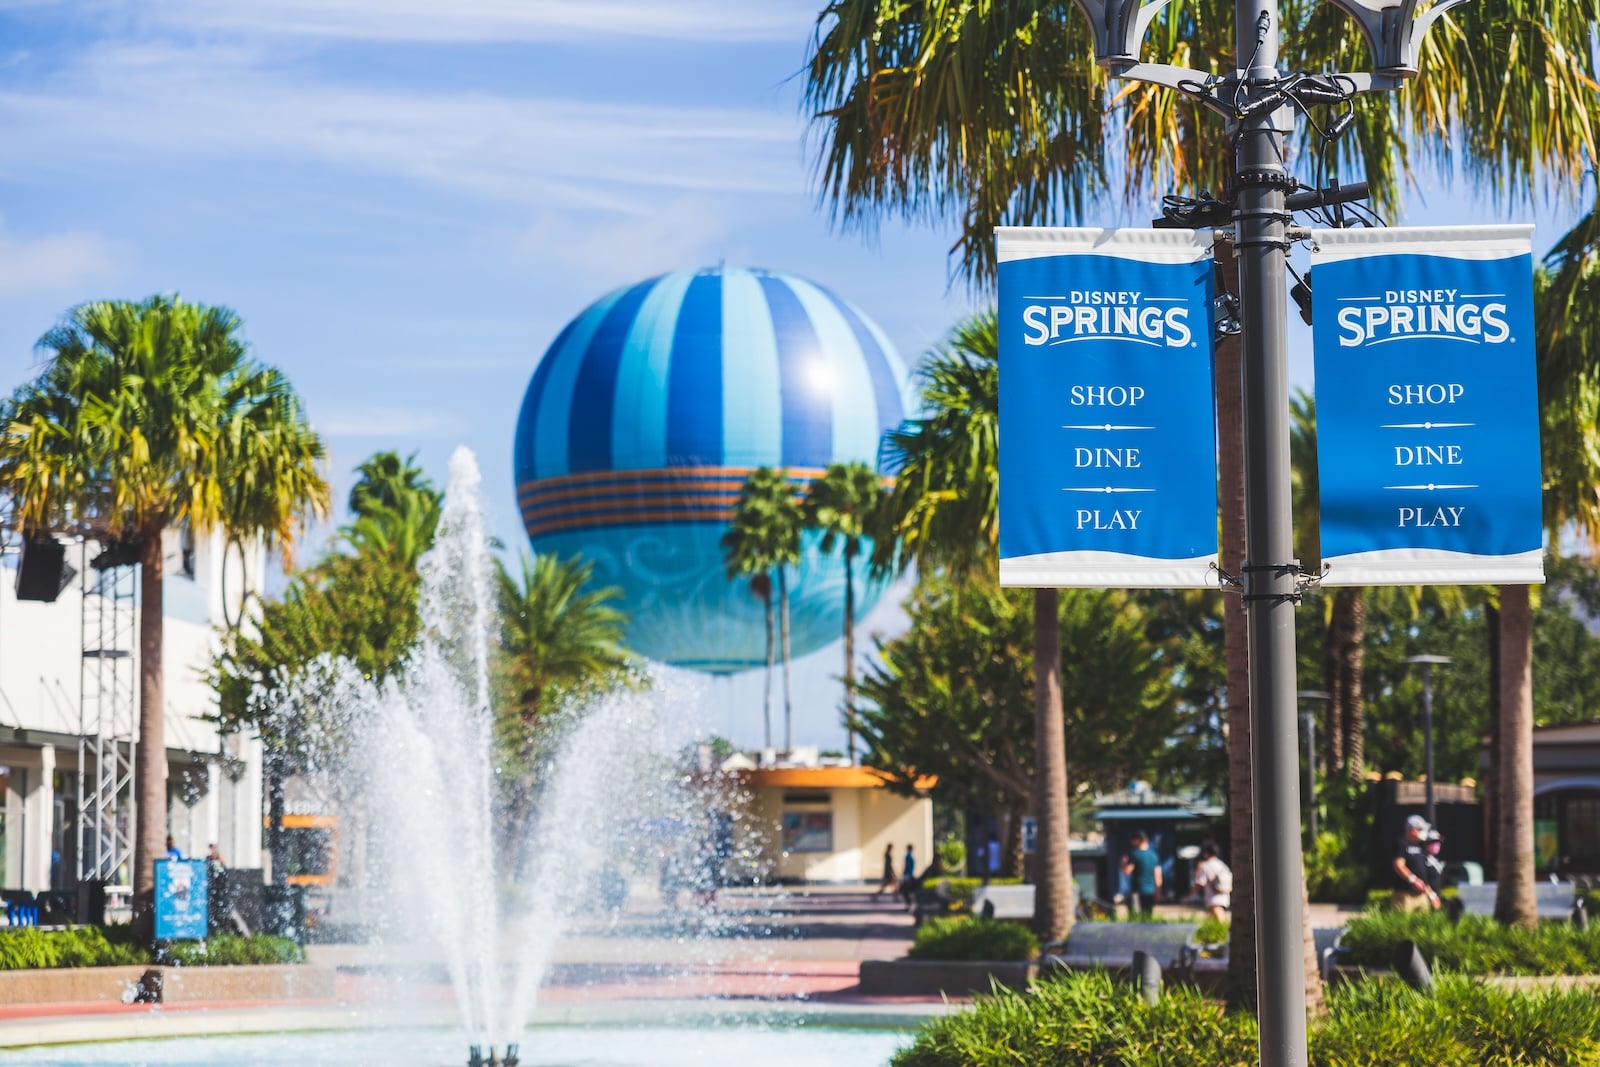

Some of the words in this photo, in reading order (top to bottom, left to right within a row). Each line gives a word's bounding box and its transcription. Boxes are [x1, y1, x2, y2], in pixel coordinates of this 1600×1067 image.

[1070, 290, 1142, 305] DISNEY
[1385, 289, 1458, 304] DISNEY
[1022, 305, 1192, 348] SPRINGS
[1337, 303, 1510, 347] SPRINGS
[1070, 385, 1145, 407] SHOP
[1388, 383, 1464, 405] SHOP
[1074, 447, 1142, 468] DINE
[1394, 445, 1463, 466] DINE
[1076, 509, 1142, 530] PLAY
[1398, 506, 1465, 527] PLAY
